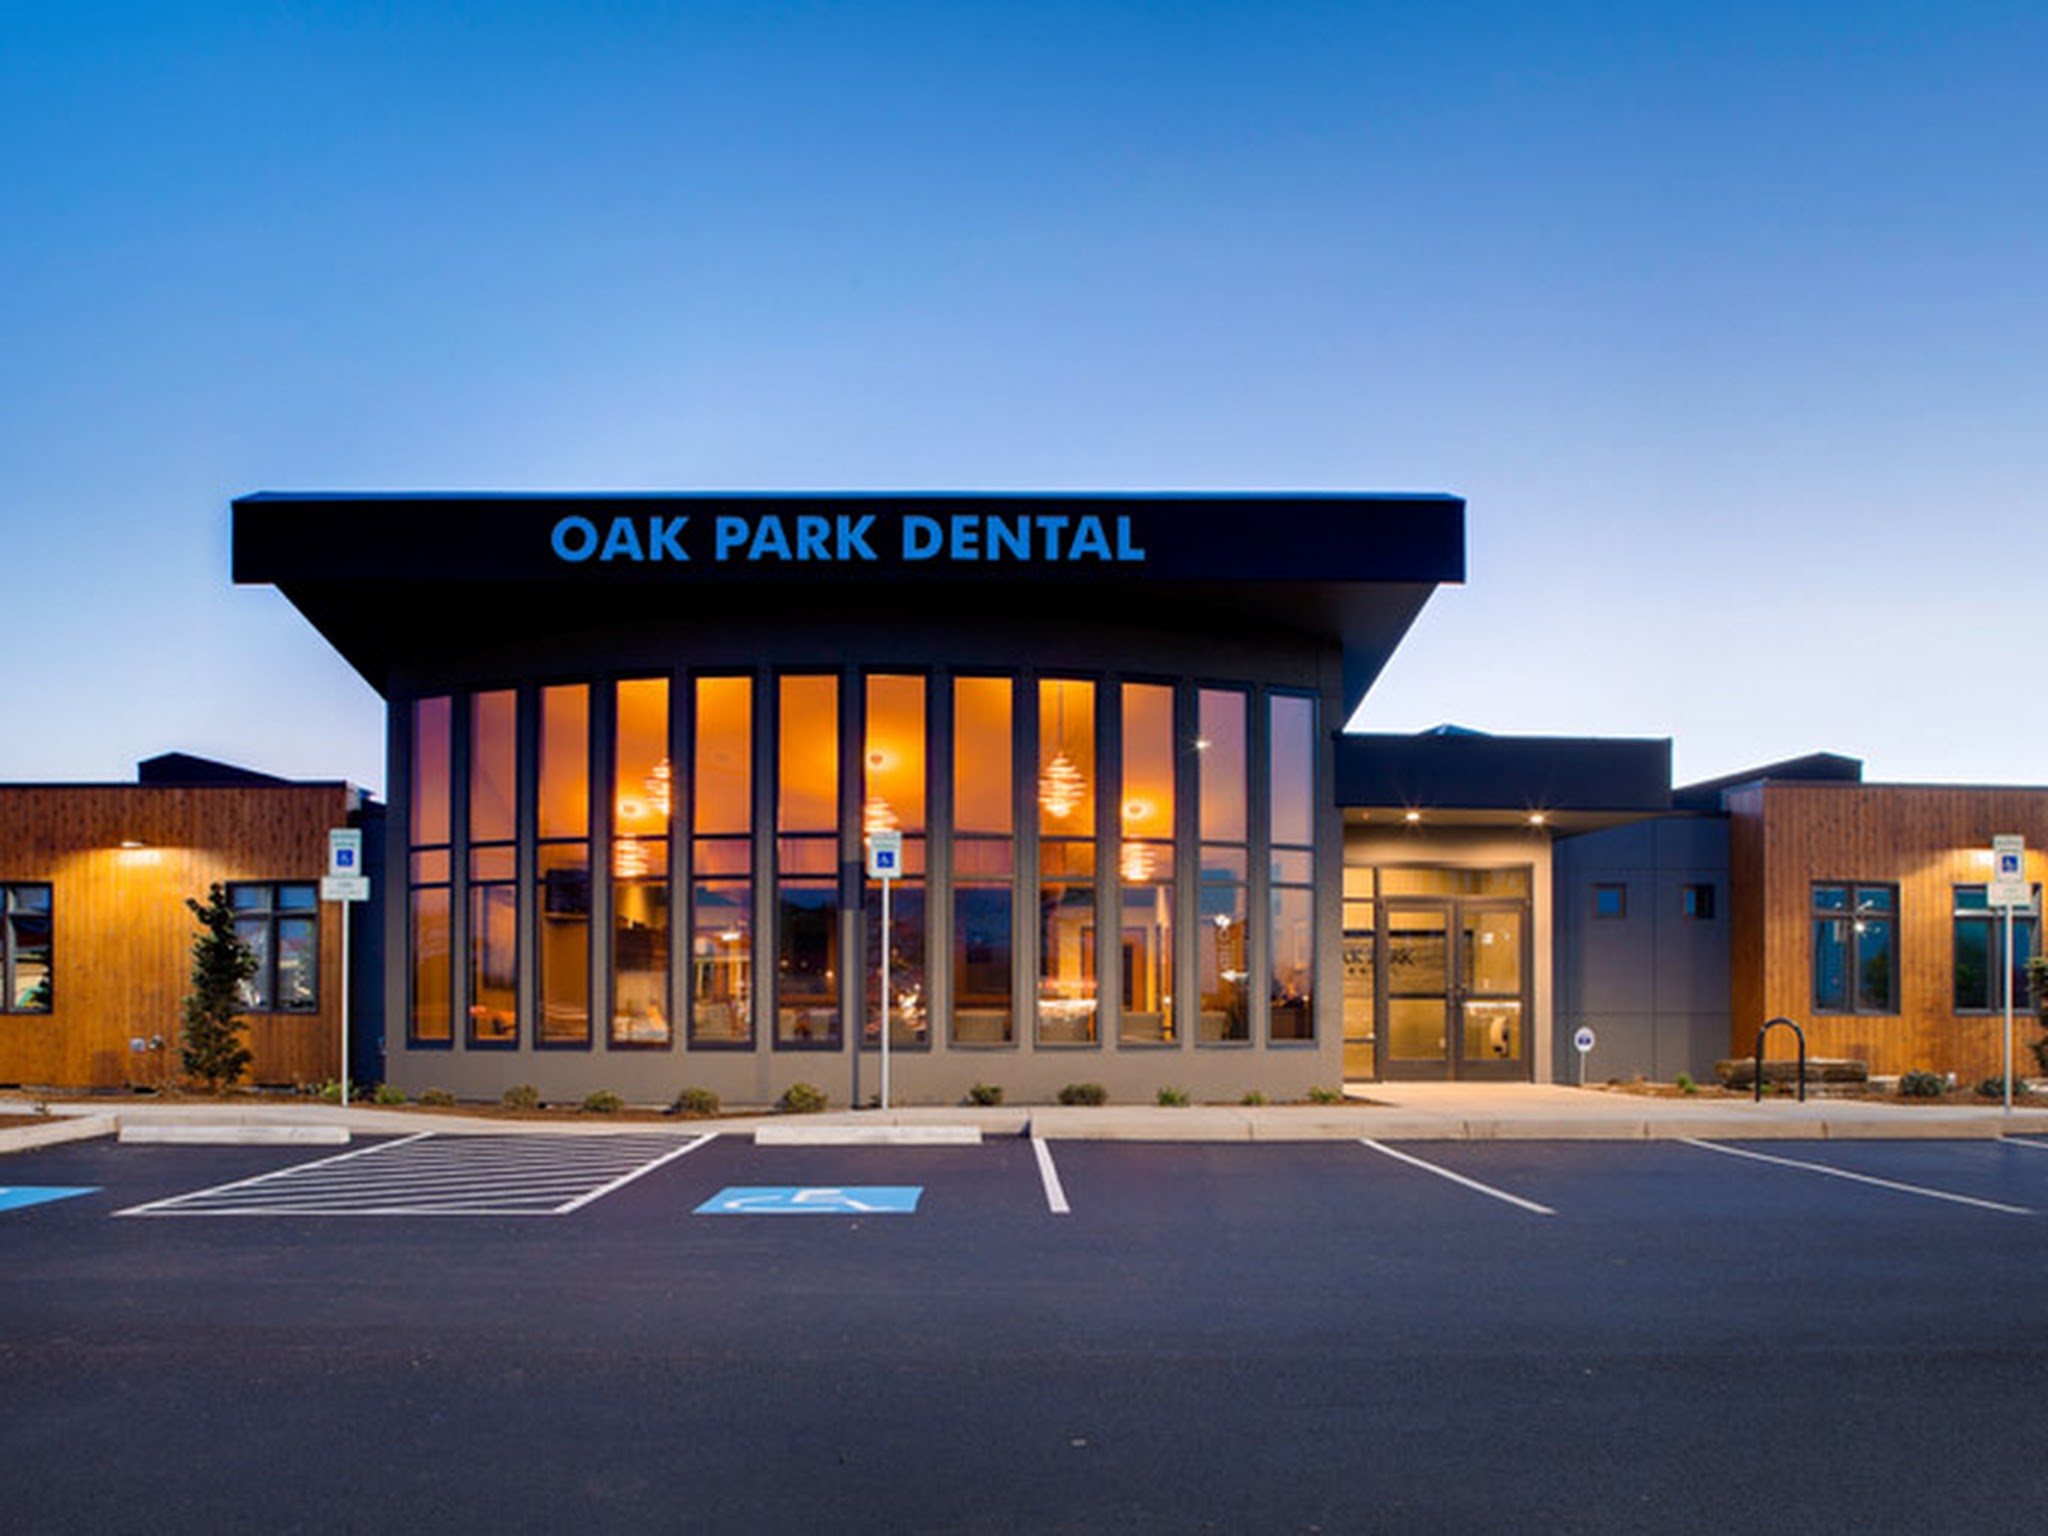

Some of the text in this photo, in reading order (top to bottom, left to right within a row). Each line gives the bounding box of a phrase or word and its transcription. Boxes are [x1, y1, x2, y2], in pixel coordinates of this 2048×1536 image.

[550, 514, 1145, 562] OAK PARK DENTAL
